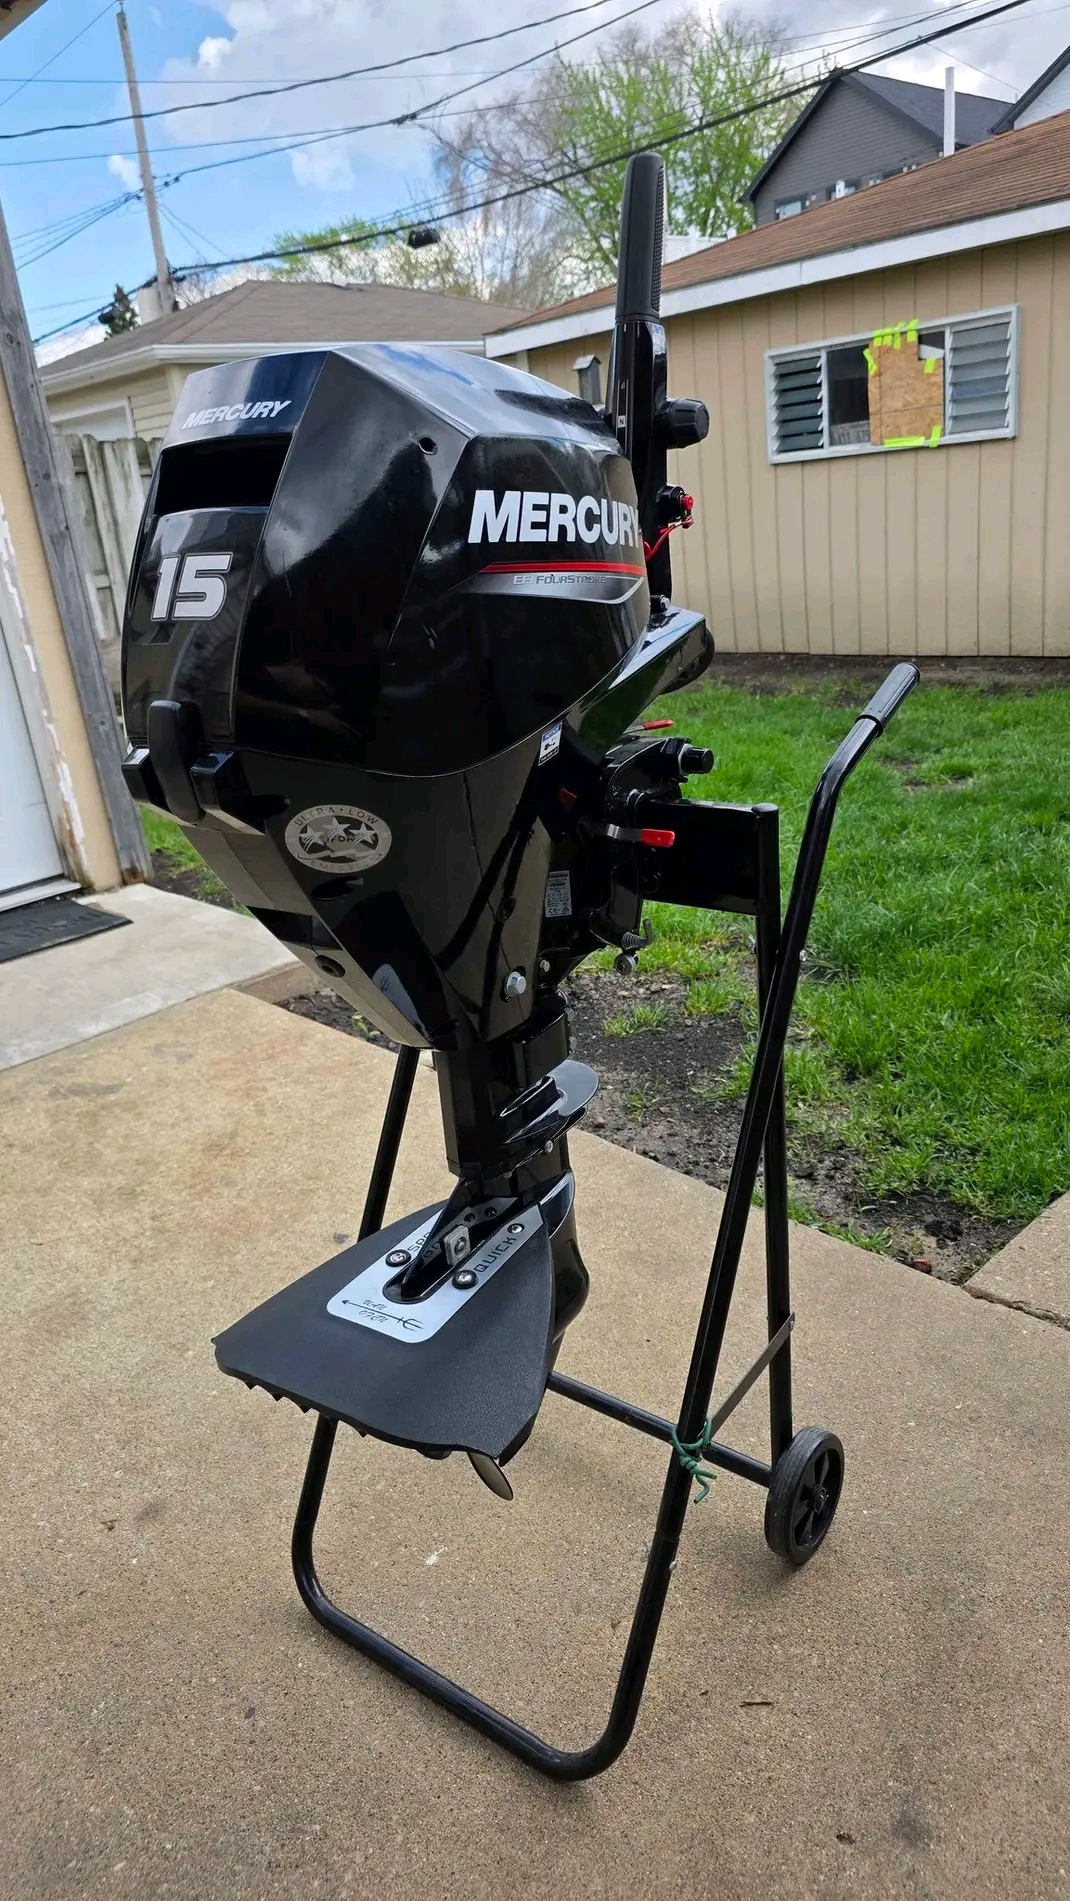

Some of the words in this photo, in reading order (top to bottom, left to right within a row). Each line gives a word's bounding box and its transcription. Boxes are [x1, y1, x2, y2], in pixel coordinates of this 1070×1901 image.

[180, 400, 292, 430] MERCURY
[467, 489, 640, 549] MERCURY
[151, 551, 234, 622] 15
[294, 806, 336, 827] ULTRA
[348, 808, 379, 825] LOW
[473, 1236, 517, 1273] QUICK
